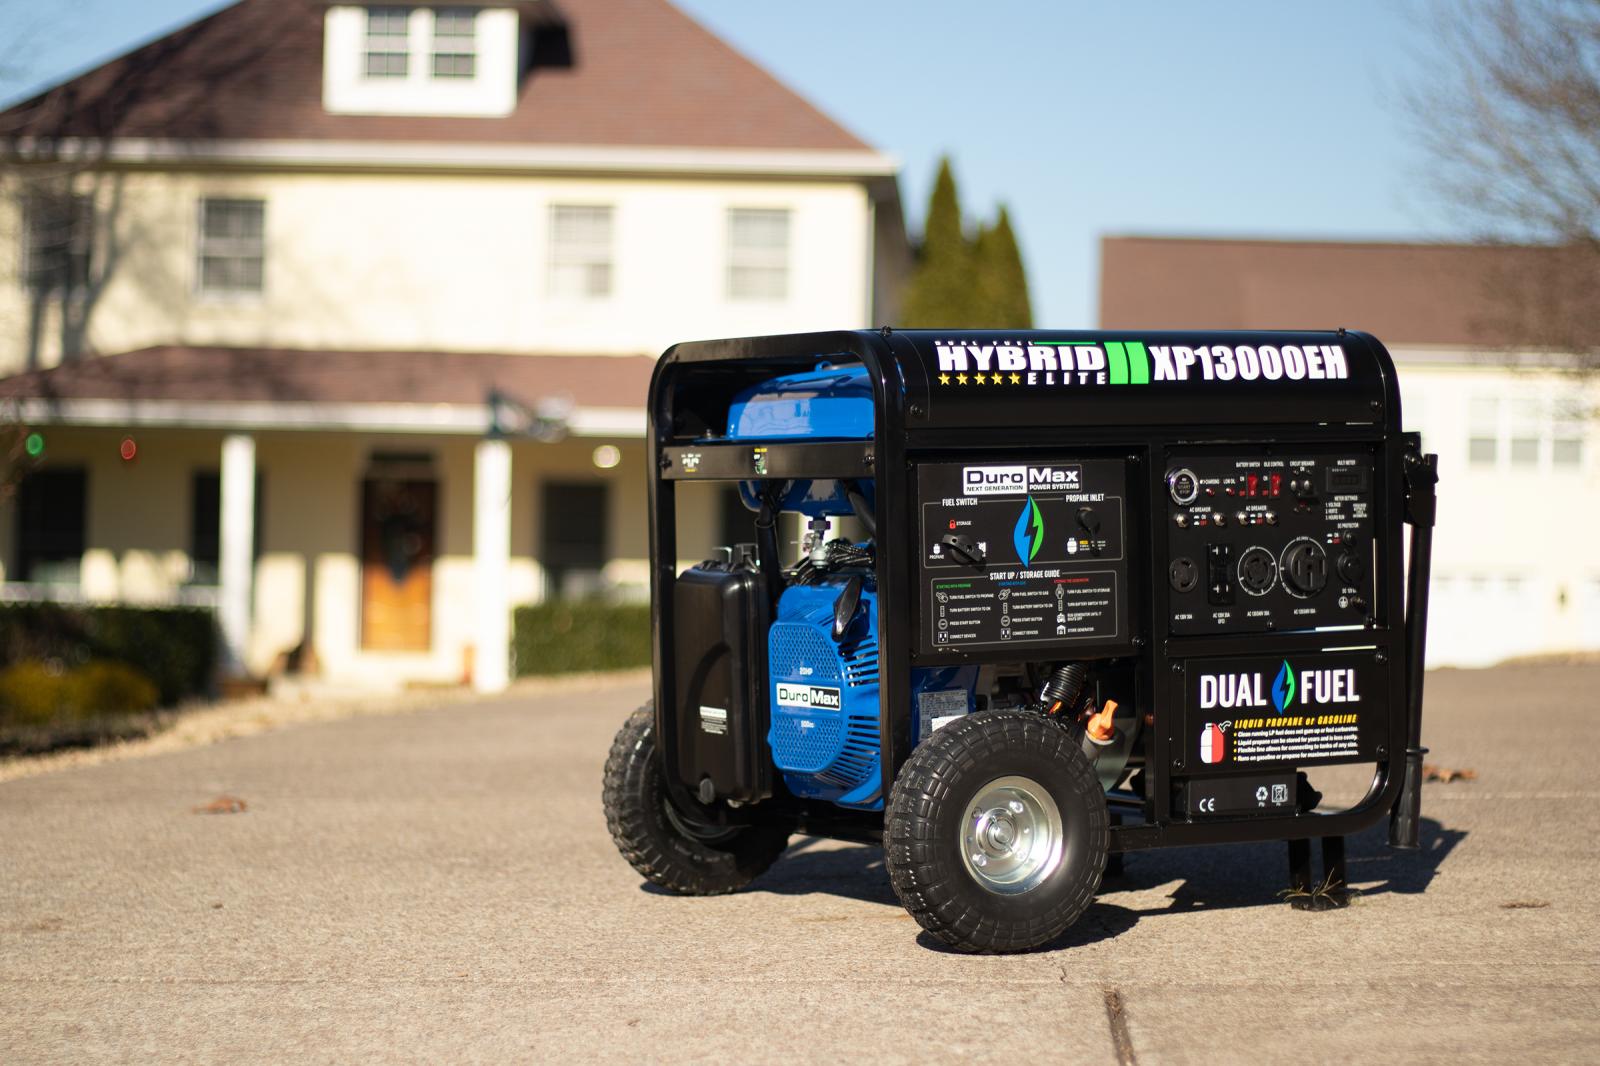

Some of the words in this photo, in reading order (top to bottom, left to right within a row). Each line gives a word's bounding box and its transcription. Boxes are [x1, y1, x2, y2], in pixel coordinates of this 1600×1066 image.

[937, 346, 1105, 371] HYBRID
[1148, 345, 1348, 380] XP13000EH
[1027, 372, 1105, 385] ELITE
[956, 498, 978, 506] SWITCH
[1066, 494, 1089, 502] PROPANE
[1090, 493, 1104, 502] INLET
[990, 572, 1006, 580] START
[1020, 570, 1043, 579] STORAGE
[1044, 569, 1060, 578] GUIDE
[1200, 673, 1267, 708] DUAL
[1301, 669, 1360, 704] FUEL
[1234, 718, 1264, 729] LIQUID
[1266, 717, 1303, 727] PROPANE
[1305, 717, 1315, 725] or
[1317, 714, 1357, 725] GASOLINE
[1199, 798, 1215, 812] CE
